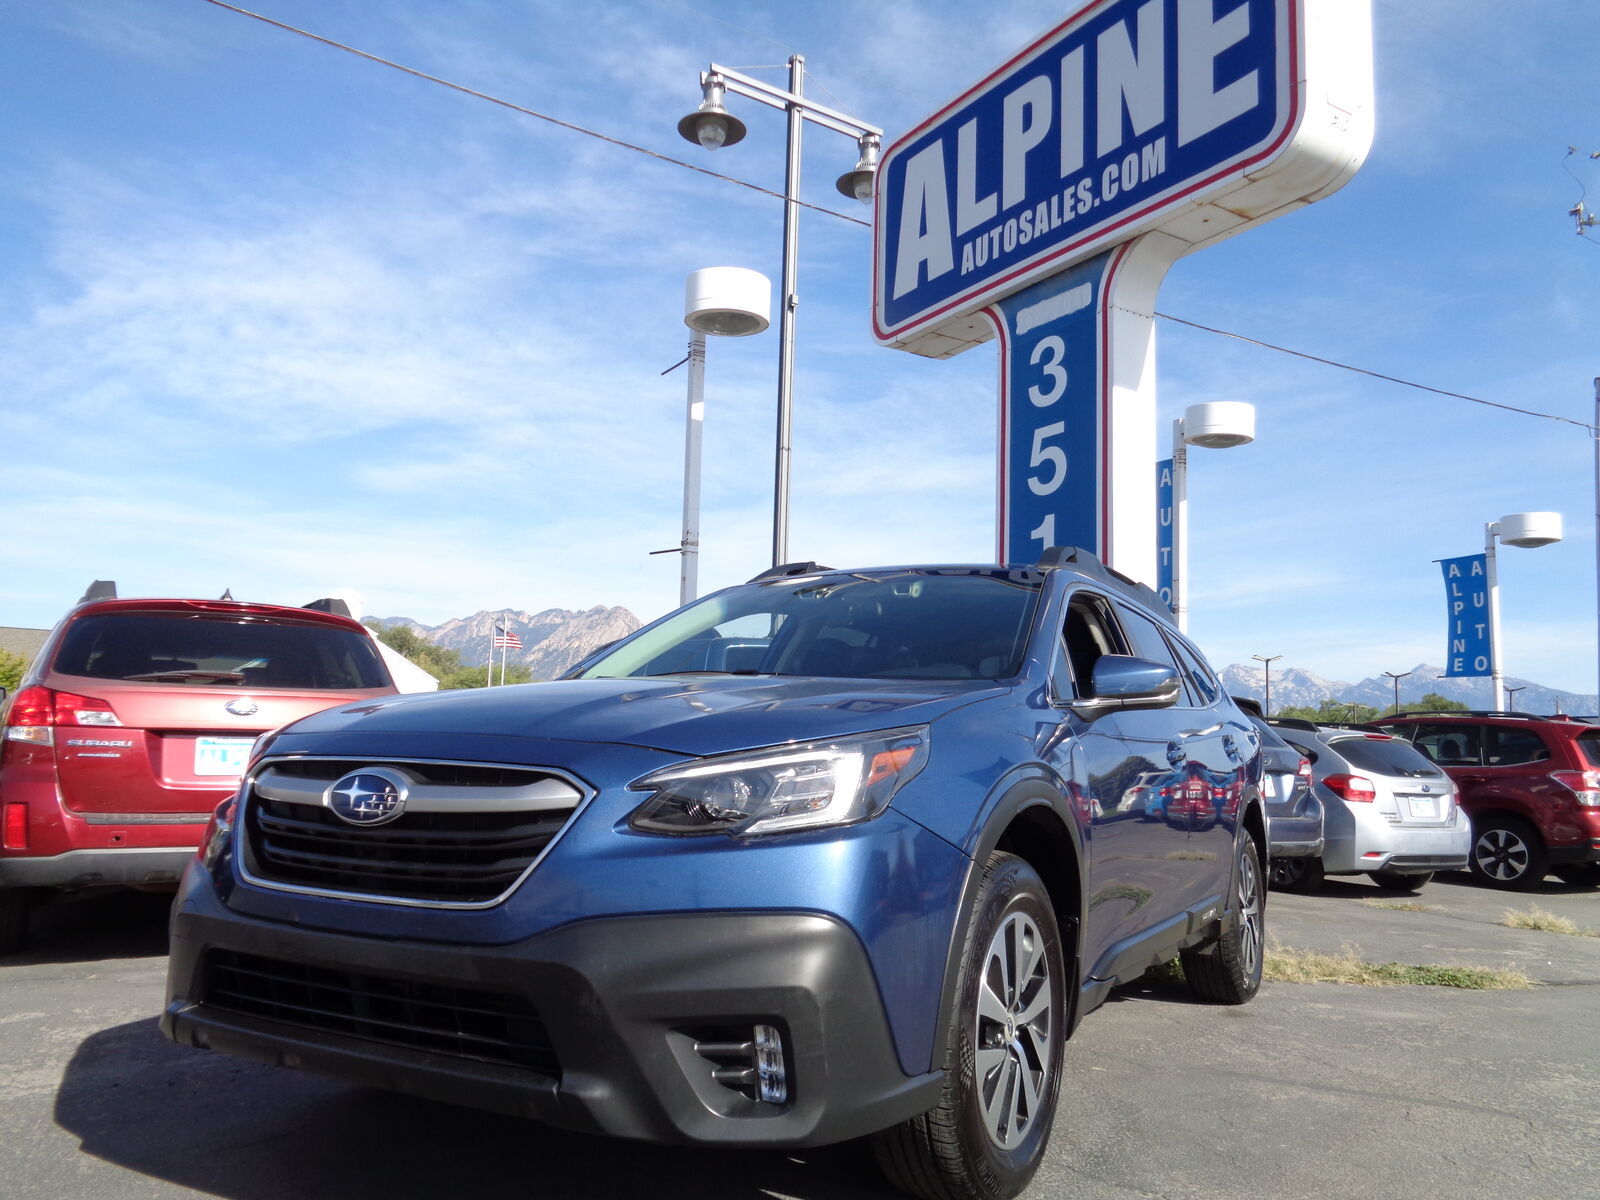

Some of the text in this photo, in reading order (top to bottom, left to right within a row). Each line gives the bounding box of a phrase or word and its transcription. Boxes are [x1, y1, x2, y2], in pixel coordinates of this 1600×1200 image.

[893, 0, 1258, 300] ALPINE
[961, 136, 1166, 276] AUTOSALES.COM
[1159, 468, 1172, 605] AUTO
[1448, 563, 1465, 672] ALPINE
[1471, 560, 1487, 671] AUTO
